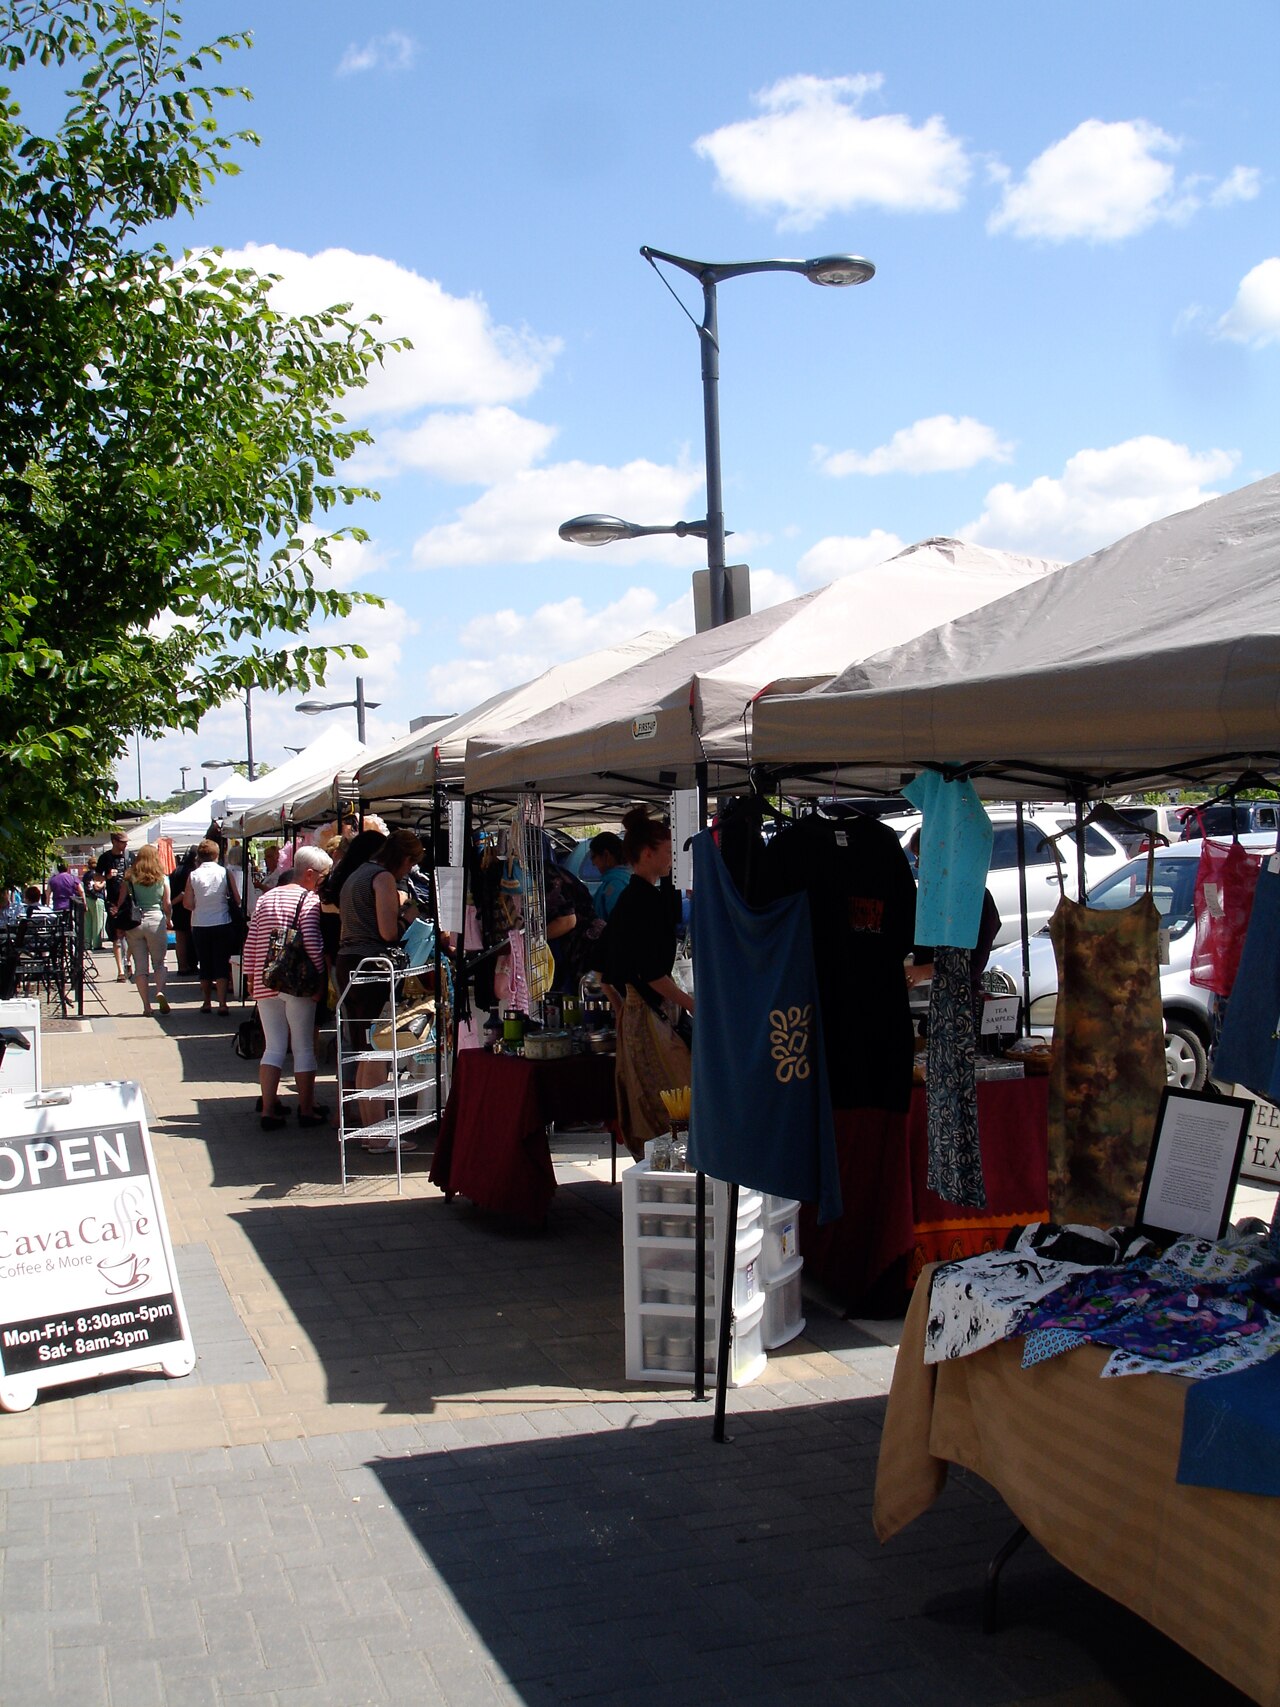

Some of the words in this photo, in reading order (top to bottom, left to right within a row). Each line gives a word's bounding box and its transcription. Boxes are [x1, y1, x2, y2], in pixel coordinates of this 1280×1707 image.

[0, 1132, 131, 1190] OPEN
[46, 1258, 56, 1272] &
[59, 1254, 93, 1270] More
[76, 1303, 173, 1332] 8:30am-5pm
[38, 1340, 73, 1362] Sat-
[75, 1327, 149, 1354] 8am-3pm
